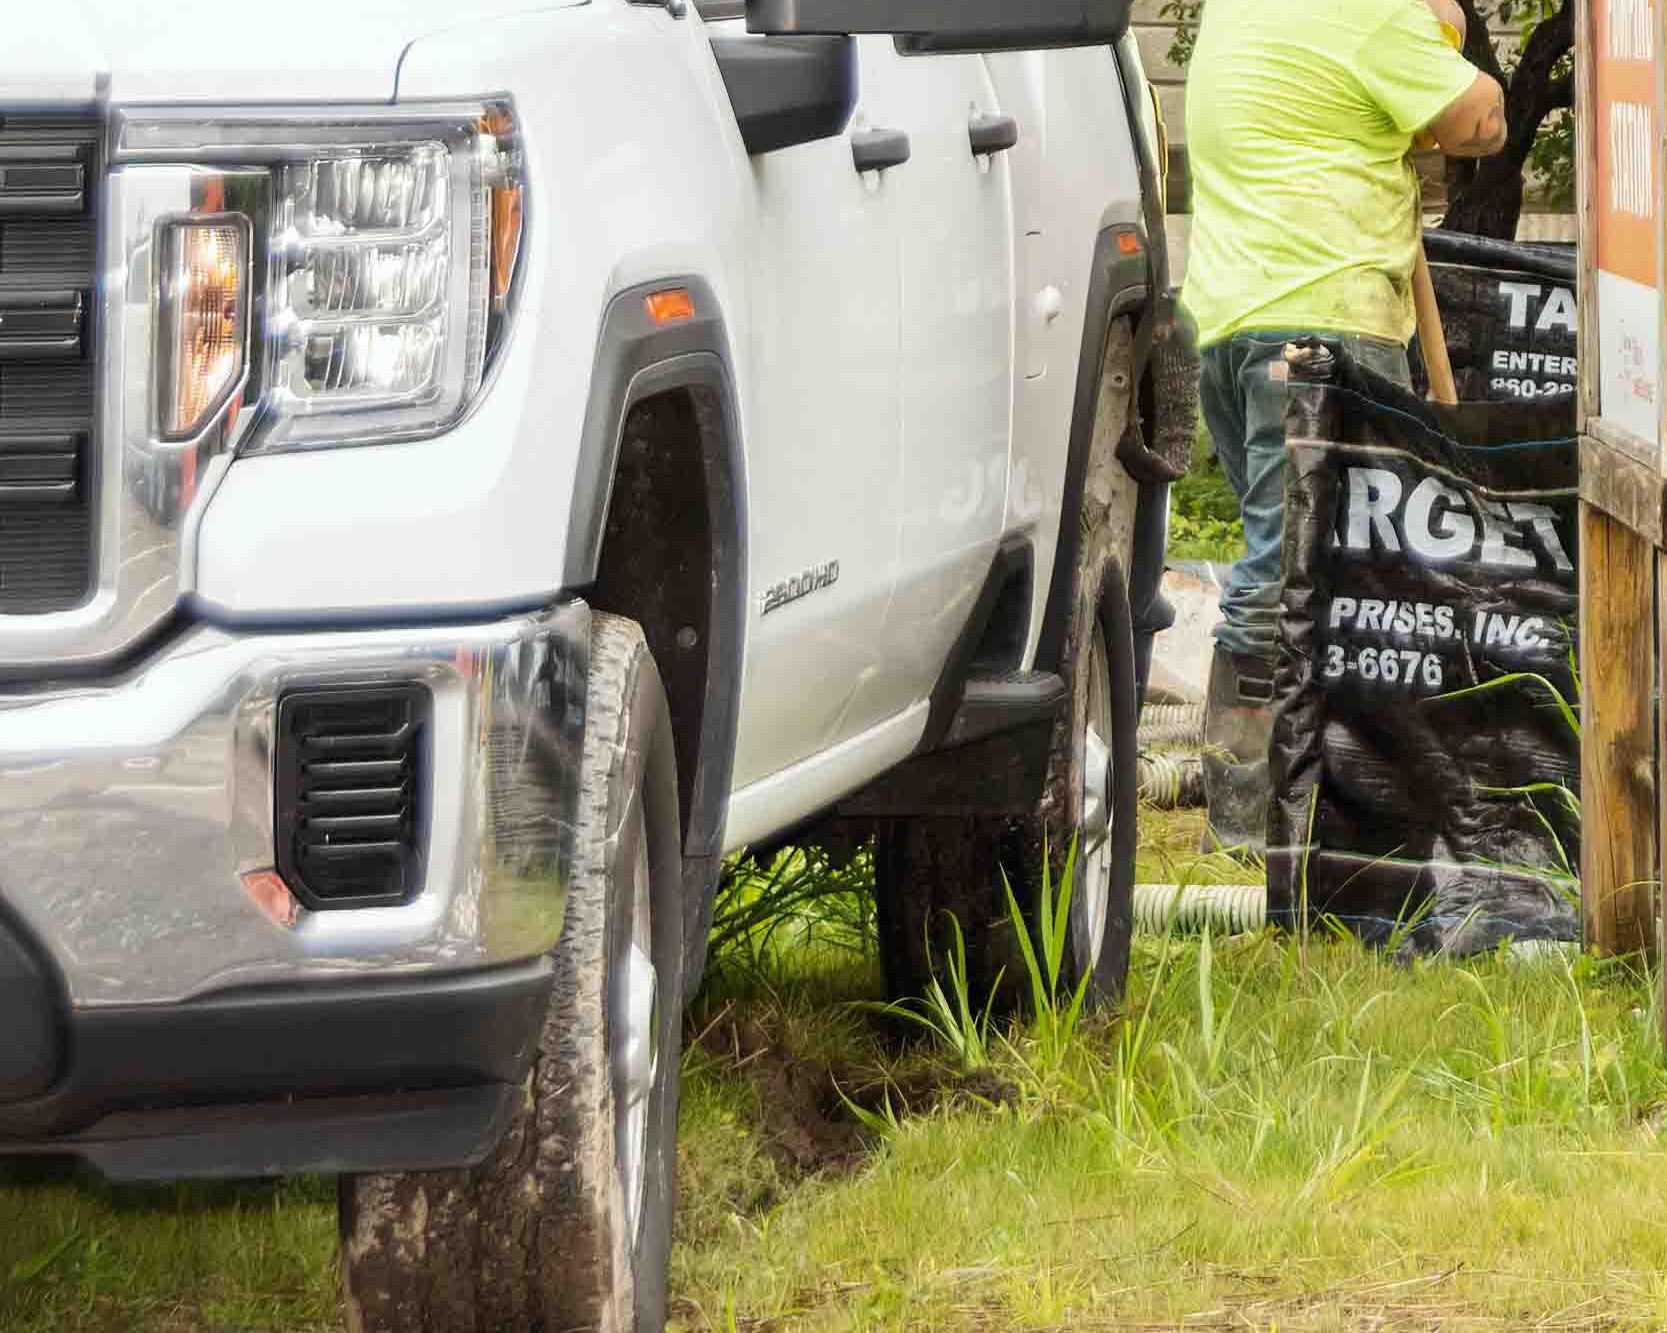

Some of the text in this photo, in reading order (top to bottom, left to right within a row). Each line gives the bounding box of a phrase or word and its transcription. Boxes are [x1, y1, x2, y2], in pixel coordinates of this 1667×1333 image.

[1491, 349, 1578, 375] ENTER
[1329, 597, 1551, 648] PRISES. INC.
[1324, 644, 1443, 687] 3-6676
